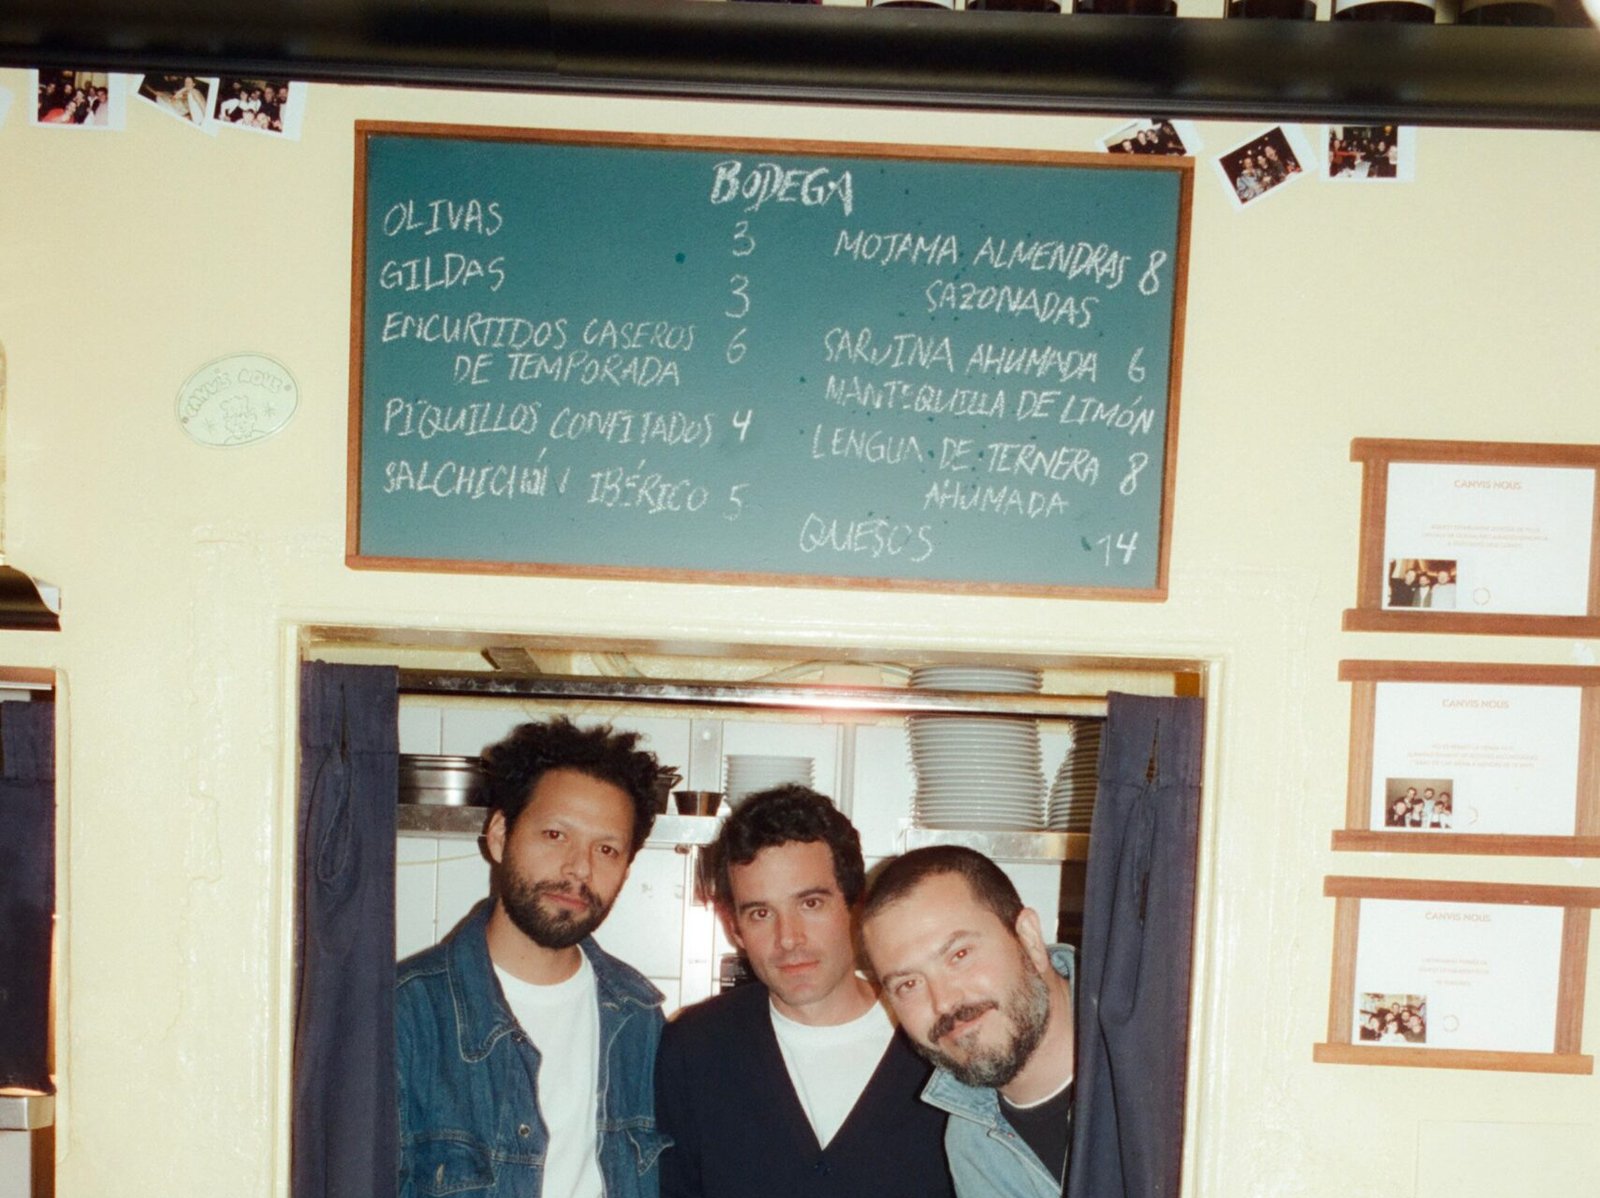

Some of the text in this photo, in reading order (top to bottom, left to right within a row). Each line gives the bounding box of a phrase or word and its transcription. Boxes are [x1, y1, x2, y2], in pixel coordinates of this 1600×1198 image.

[710, 160, 854, 216] BODEGA
[384, 199, 756, 257] OLIVAS 3
[380, 252, 750, 318] GILDAS 3
[834, 229, 1167, 295] MOJAMA ALMENDRAS 8
[926, 279, 1100, 330] SAZONADAS
[381, 312, 747, 364] ENCURTIDOS CASEROS 6
[966, 343, 1098, 382] AHUMADA
[1128, 347, 1145, 382] 6
[454, 351, 680, 387] DE TEMPORADA
[384, 397, 753, 446] PIQUILLOS CONFITADOS 4
[1016, 390, 1061, 423] DE
[1060, 395, 1155, 435] LIMÓN
[813, 424, 1148, 495] LENGUA DE TERNERA 8
[721, 483, 752, 521] 5
[924, 480, 1069, 519] AHUMADA
[800, 513, 1138, 565] QUESOS 14
[1442, 698, 1509, 710] CANVIS NOUS
[1424, 911, 1492, 923] CANVIS NOUS
